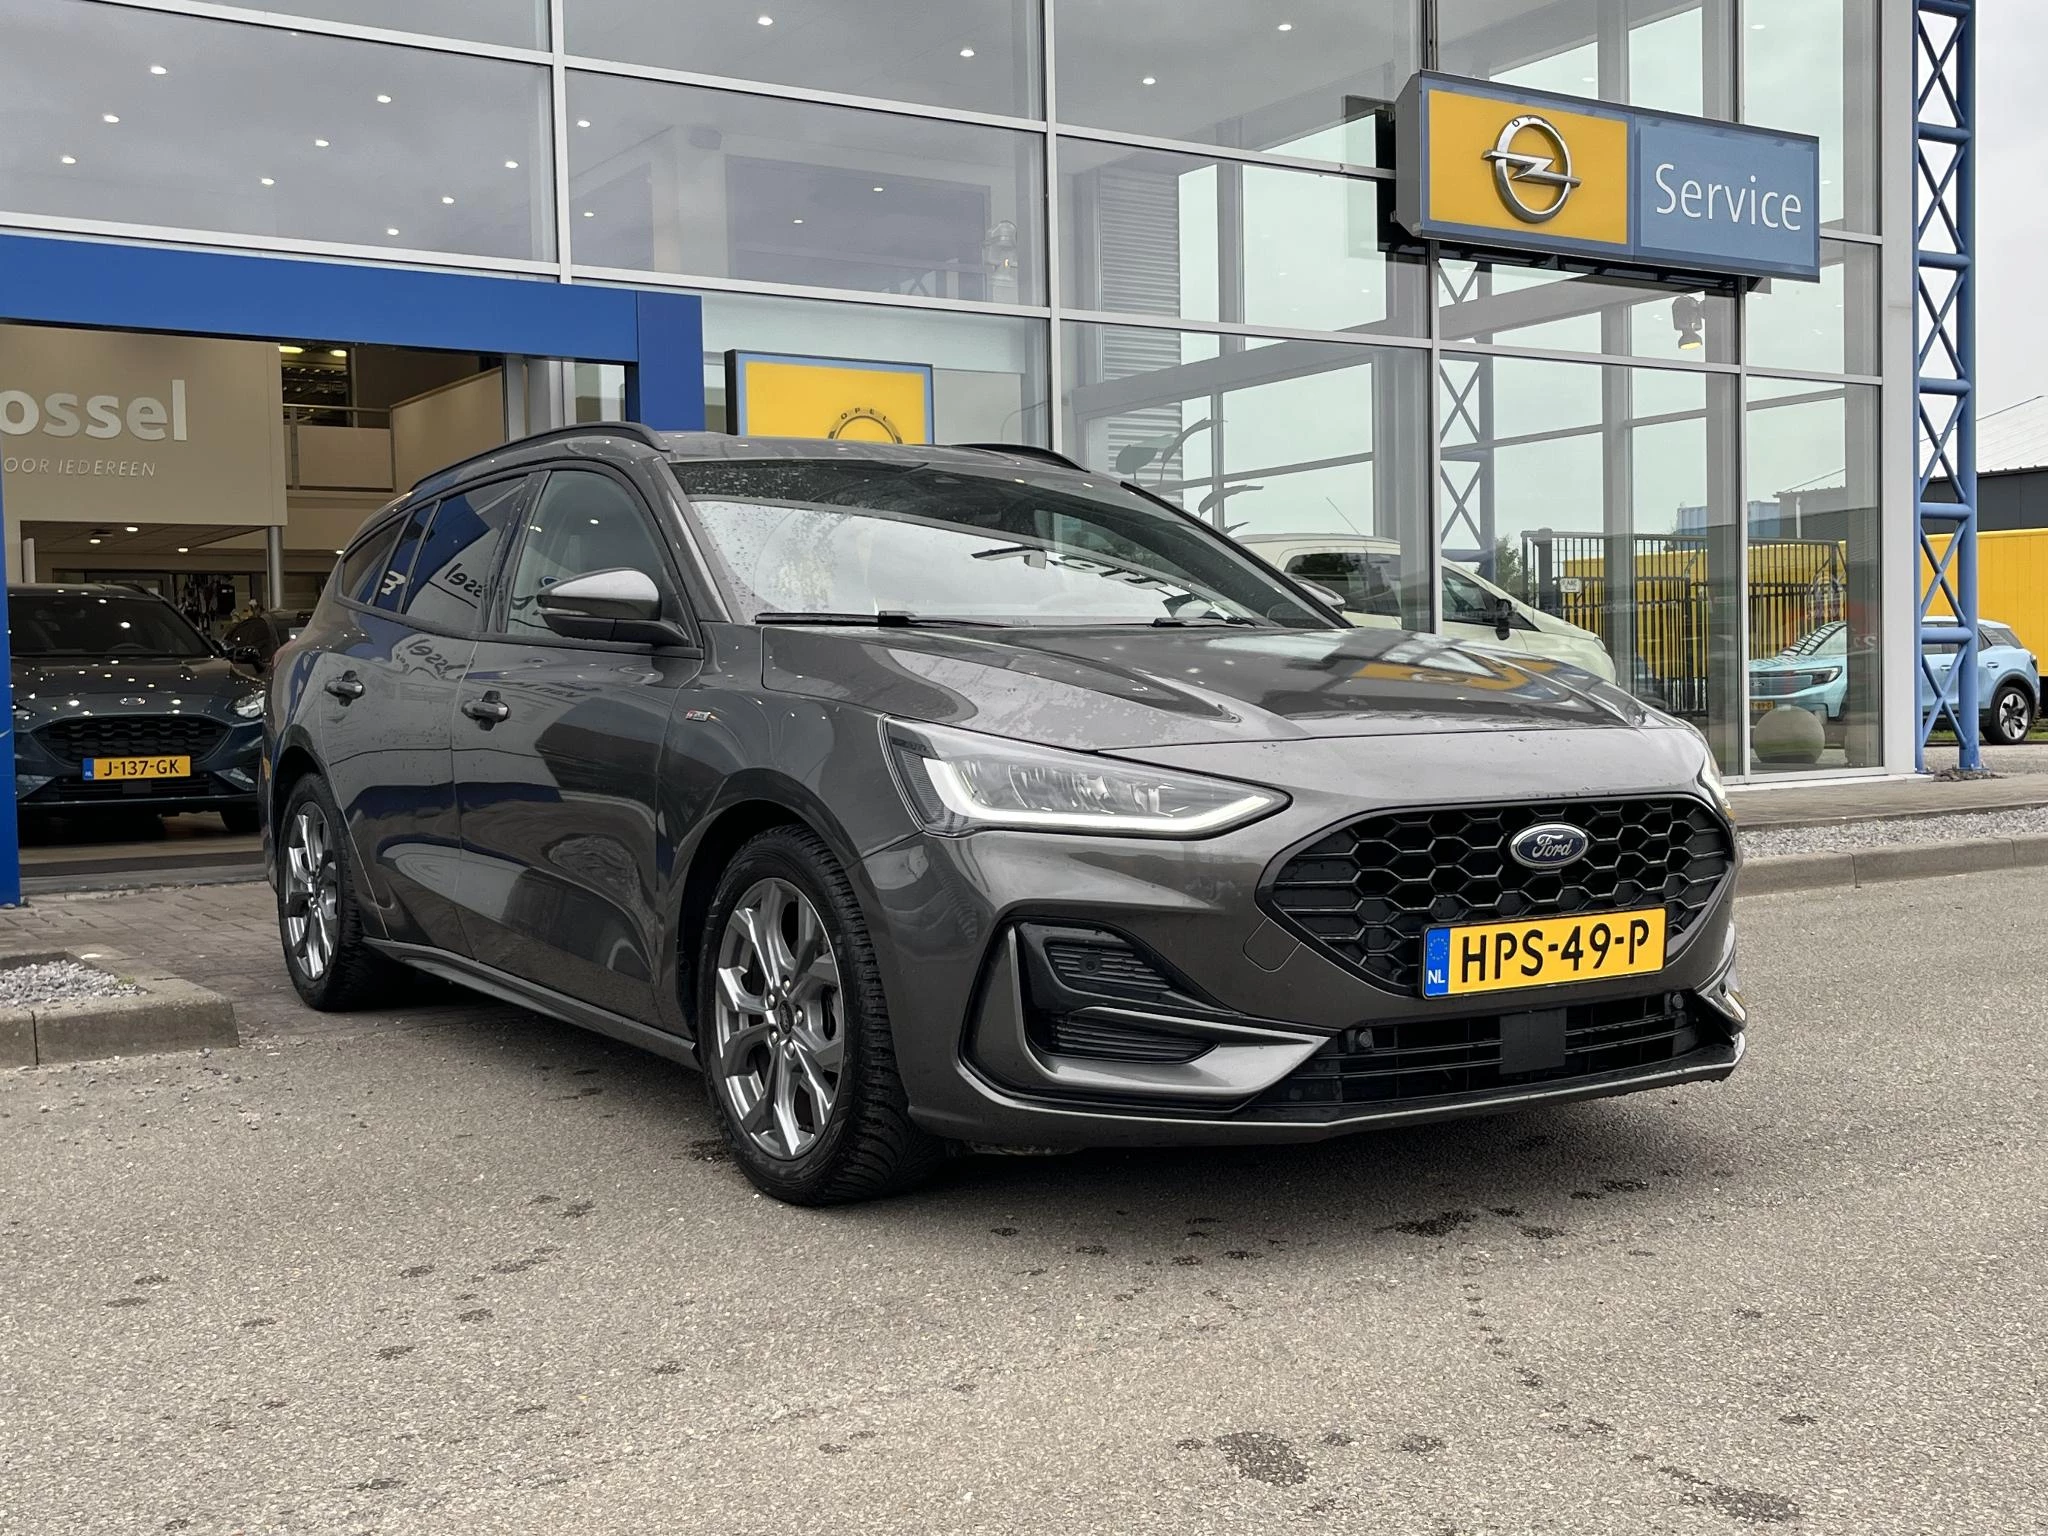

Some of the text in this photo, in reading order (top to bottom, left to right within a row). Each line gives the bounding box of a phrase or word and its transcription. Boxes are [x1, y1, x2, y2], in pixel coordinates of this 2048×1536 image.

[1655, 163, 1801, 231] Service
[840, 407, 887, 421] OPEL
[58, 459, 156, 477] IEDEREEN
[103, 759, 180, 777] J-137-GK
[1532, 834, 1573, 858] Ford
[1461, 918, 1650, 984] HPS-49-P
[1427, 969, 1446, 985] NL
